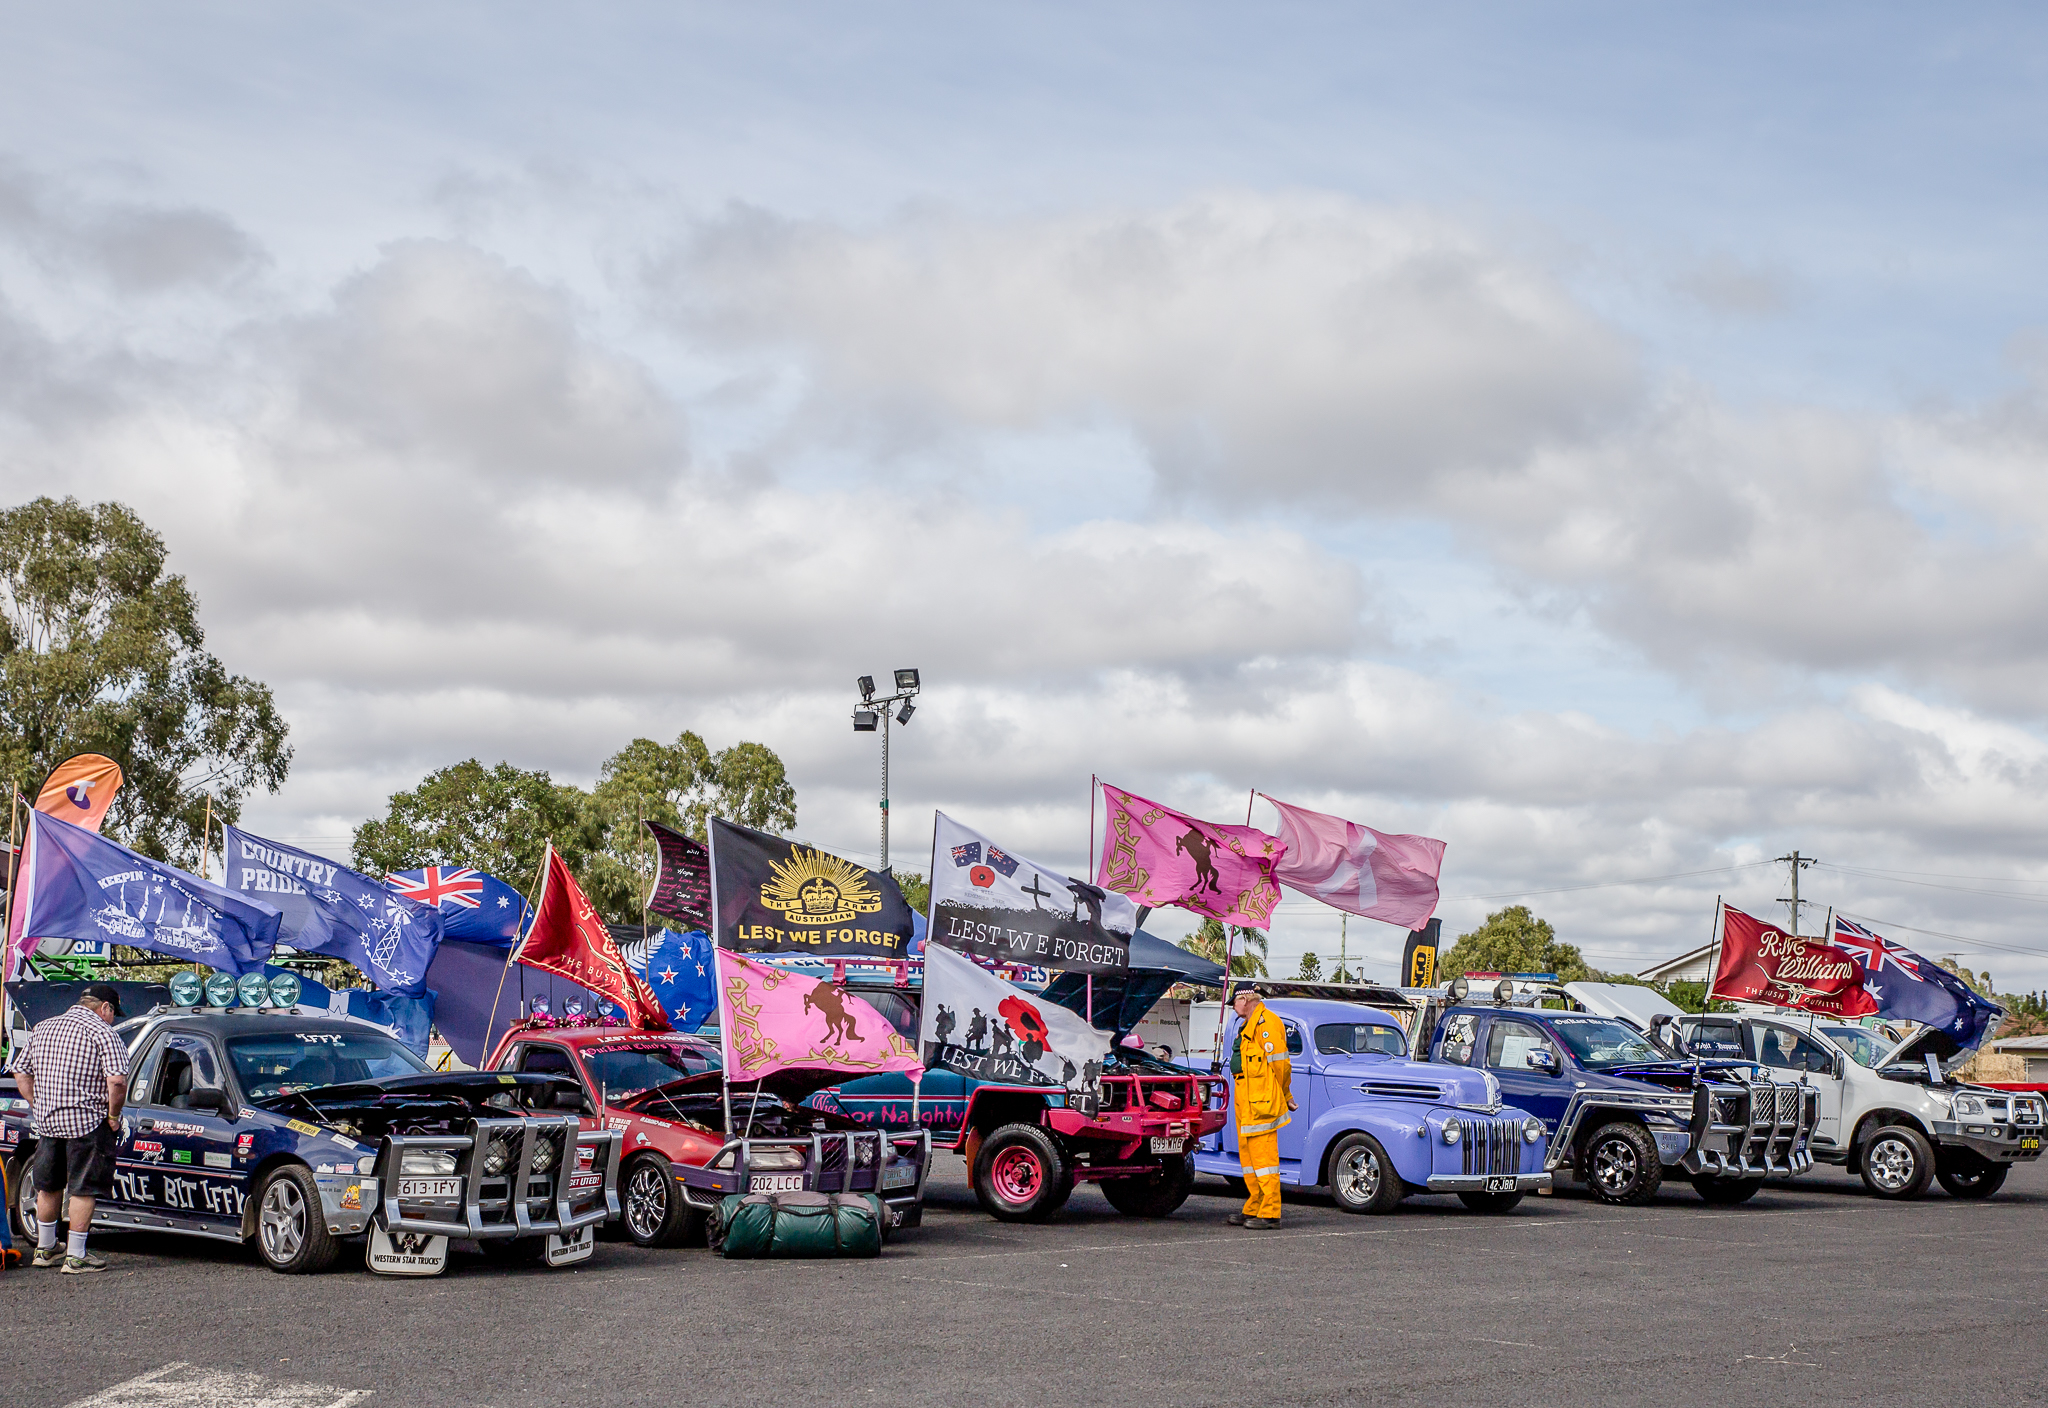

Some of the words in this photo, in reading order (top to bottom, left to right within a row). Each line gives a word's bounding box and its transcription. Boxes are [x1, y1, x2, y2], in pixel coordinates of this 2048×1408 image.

[241, 840, 338, 887] COUNTRY
[677, 868, 694, 877] Hope
[151, 873, 167, 883] IT
[241, 868, 306, 895] PRIDE
[769, 900, 792, 908] THE
[788, 912, 852, 923] AUSTRALIAN
[843, 901, 876, 911] ARMY
[738, 925, 785, 944] LEST
[789, 930, 821, 945] WE
[826, 928, 901, 949] FORGET
[947, 916, 1001, 946] LEST
[1053, 937, 1124, 967] FORGET
[561, 954, 583, 968] THE
[587, 967, 617, 985] BUSH
[1776, 954, 1853, 980] Williams
[1745, 986, 1763, 996] THE
[597, 1035, 627, 1043] LEST
[650, 1035, 694, 1043] FORGET
[941, 1046, 988, 1072] LEST
[993, 1059, 1023, 1078] WE
[812, 1094, 839, 1114] Nice
[882, 1104, 965, 1128] Naghty
[154, 1120, 172, 1129] MR
[177, 1123, 205, 1134] SKID
[134, 1140, 162, 1152] MAXXIS
[580, 1176, 600, 1186] UTED!
[163, 1175, 198, 1208] BIT
[200, 1179, 246, 1214] IFFY
[374, 1254, 401, 1263] WESTERN
[402, 1256, 417, 1264] STAR
[418, 1257, 439, 1265] TRUCKS
[551, 1247, 568, 1258] WESTERN
[569, 1245, 578, 1254] STAR
